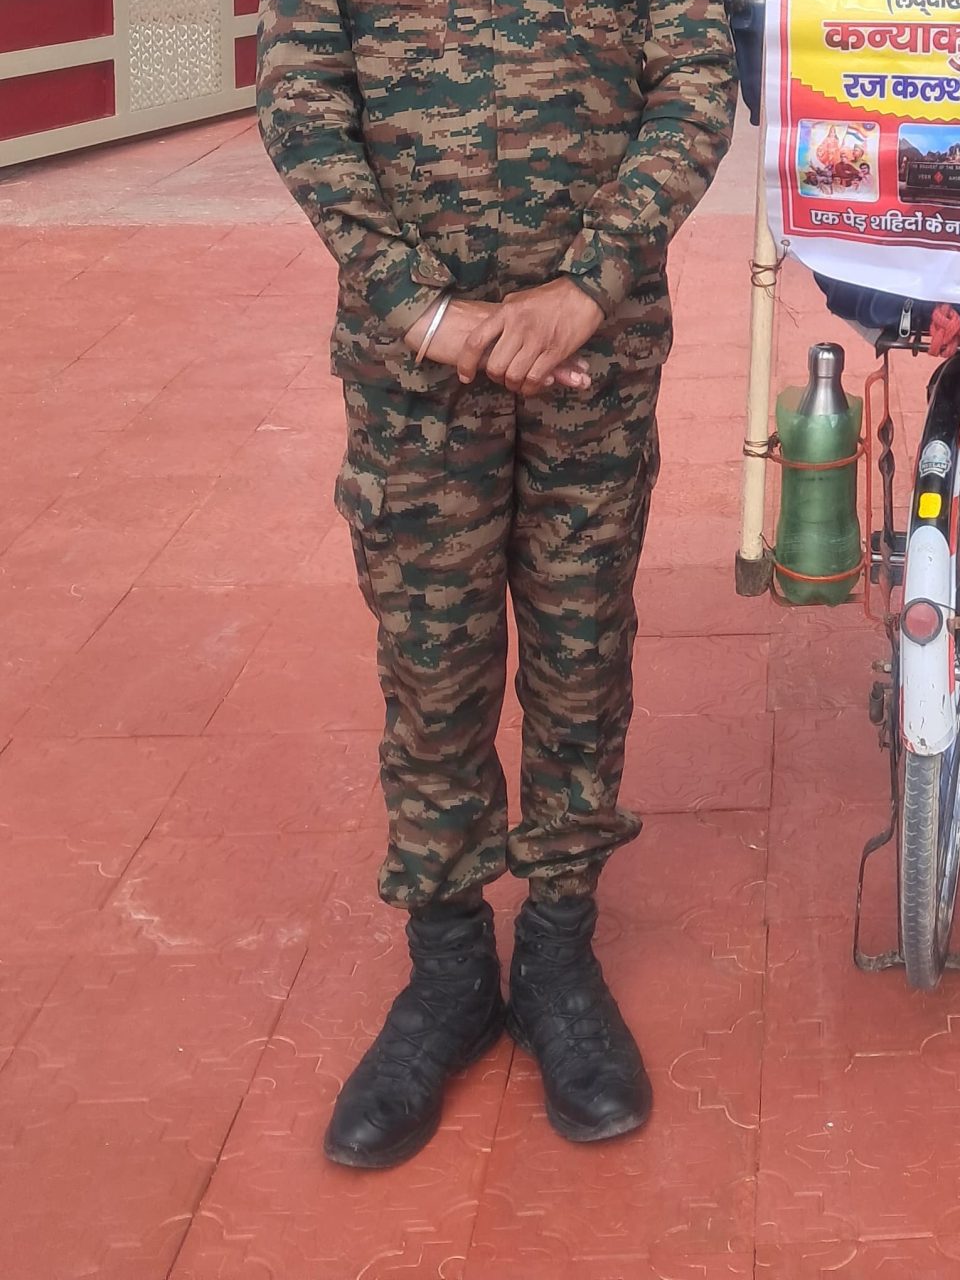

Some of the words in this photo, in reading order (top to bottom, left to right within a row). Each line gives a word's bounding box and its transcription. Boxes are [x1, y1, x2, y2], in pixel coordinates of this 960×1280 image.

[843, 73, 888, 98] रज
[810, 210, 840, 224] एक
[925, 213, 943, 233] के
